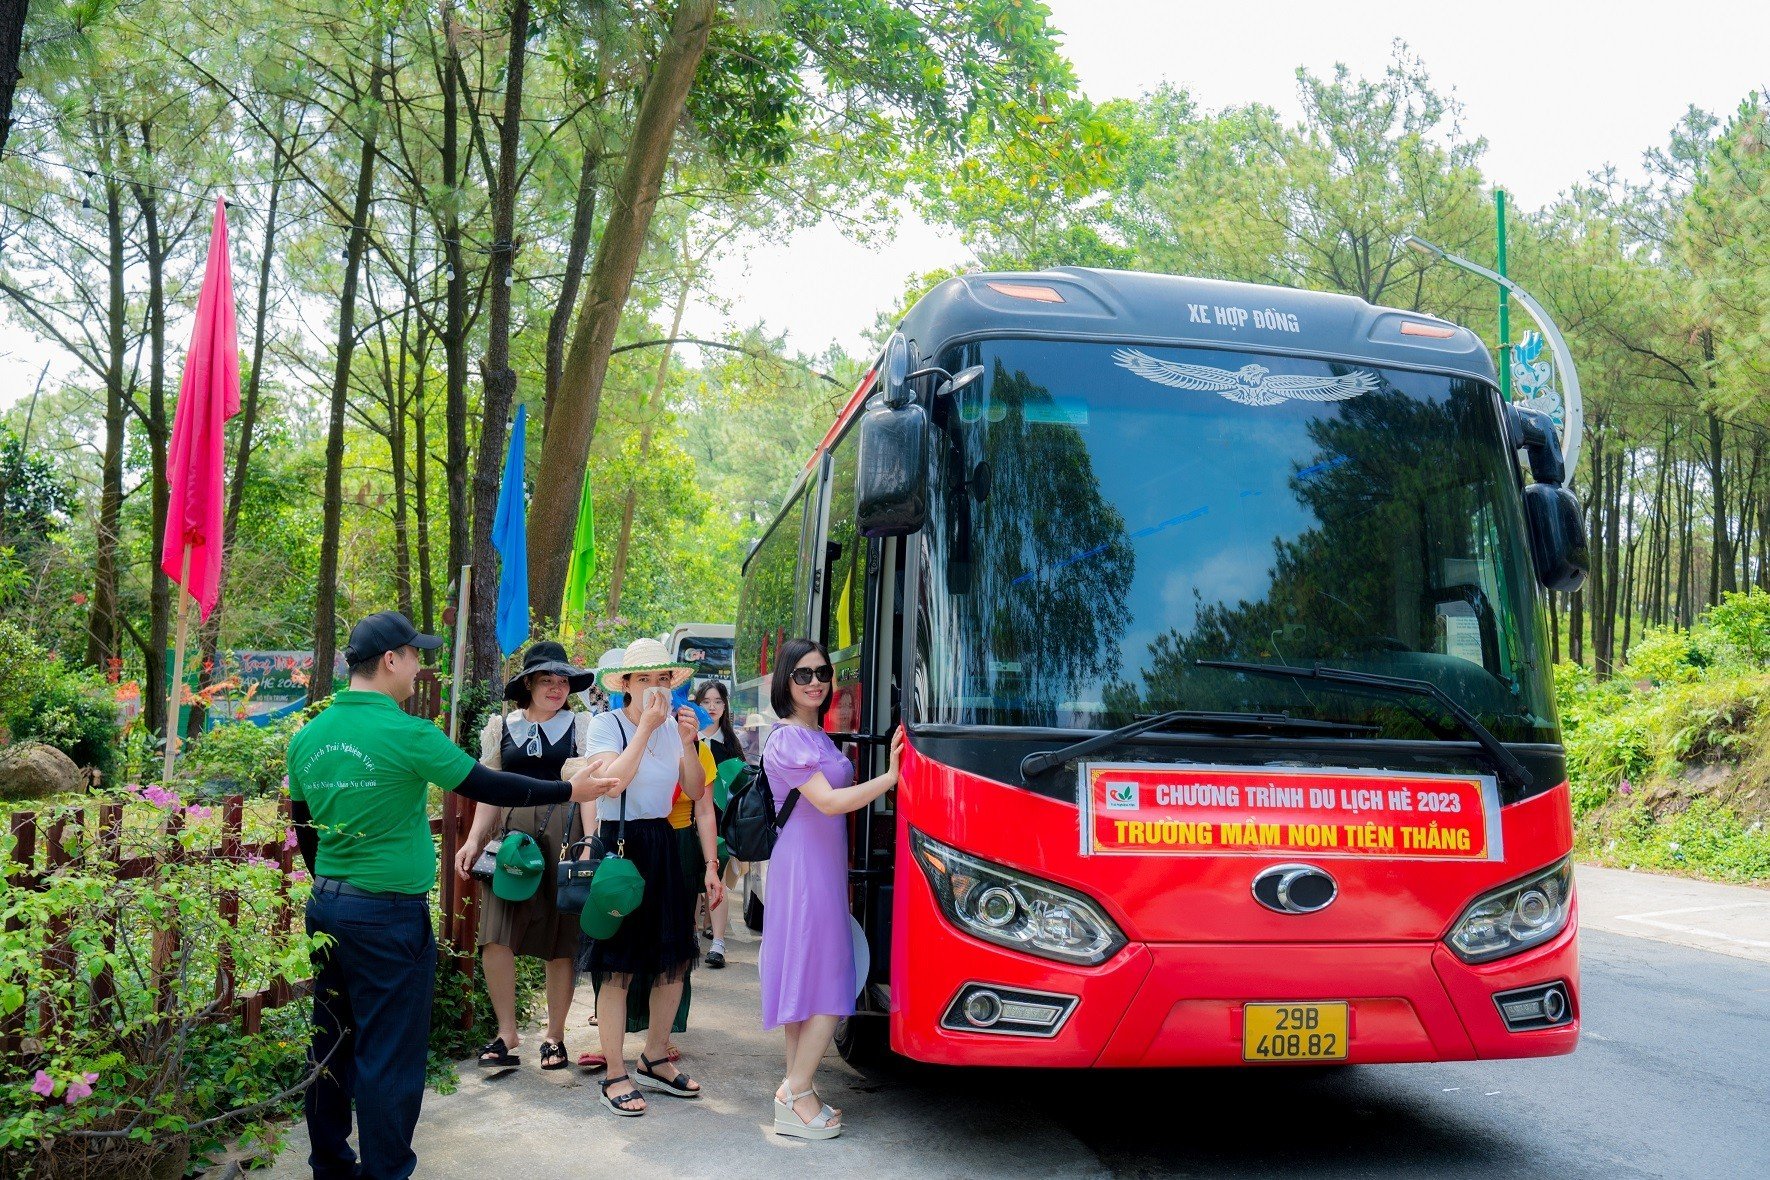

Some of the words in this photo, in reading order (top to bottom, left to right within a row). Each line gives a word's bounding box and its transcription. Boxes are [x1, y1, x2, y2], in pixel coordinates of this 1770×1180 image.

[1187, 303, 1211, 324] XE
[1213, 305, 1249, 331] HỢP
[1252, 307, 1300, 333] ĐỒNG
[303, 762, 312, 774] Du
[310, 748, 325, 763] Lịch
[325, 741, 340, 753] Trải
[340, 742, 363, 758] Nghiệm
[362, 754, 376, 773] Việt
[1156, 783, 1239, 807] CHƯƠNG
[1245, 783, 1304, 808] TRÌNH
[1309, 788, 1336, 809] DU
[1341, 789, 1384, 814] LỊCH
[1388, 787, 1412, 811] HÈ
[1417, 791, 1461, 813] 2023
[1114, 815, 1213, 845] TRƯỜNG
[1220, 816, 1281, 845] MẦM
[1288, 823, 1337, 847] NON
[1344, 821, 1394, 849] TIÊN
[1400, 819, 1471, 850] THẮNG
[1276, 1008, 1319, 1030] 29B
[1256, 1033, 1336, 1057] 408.82
